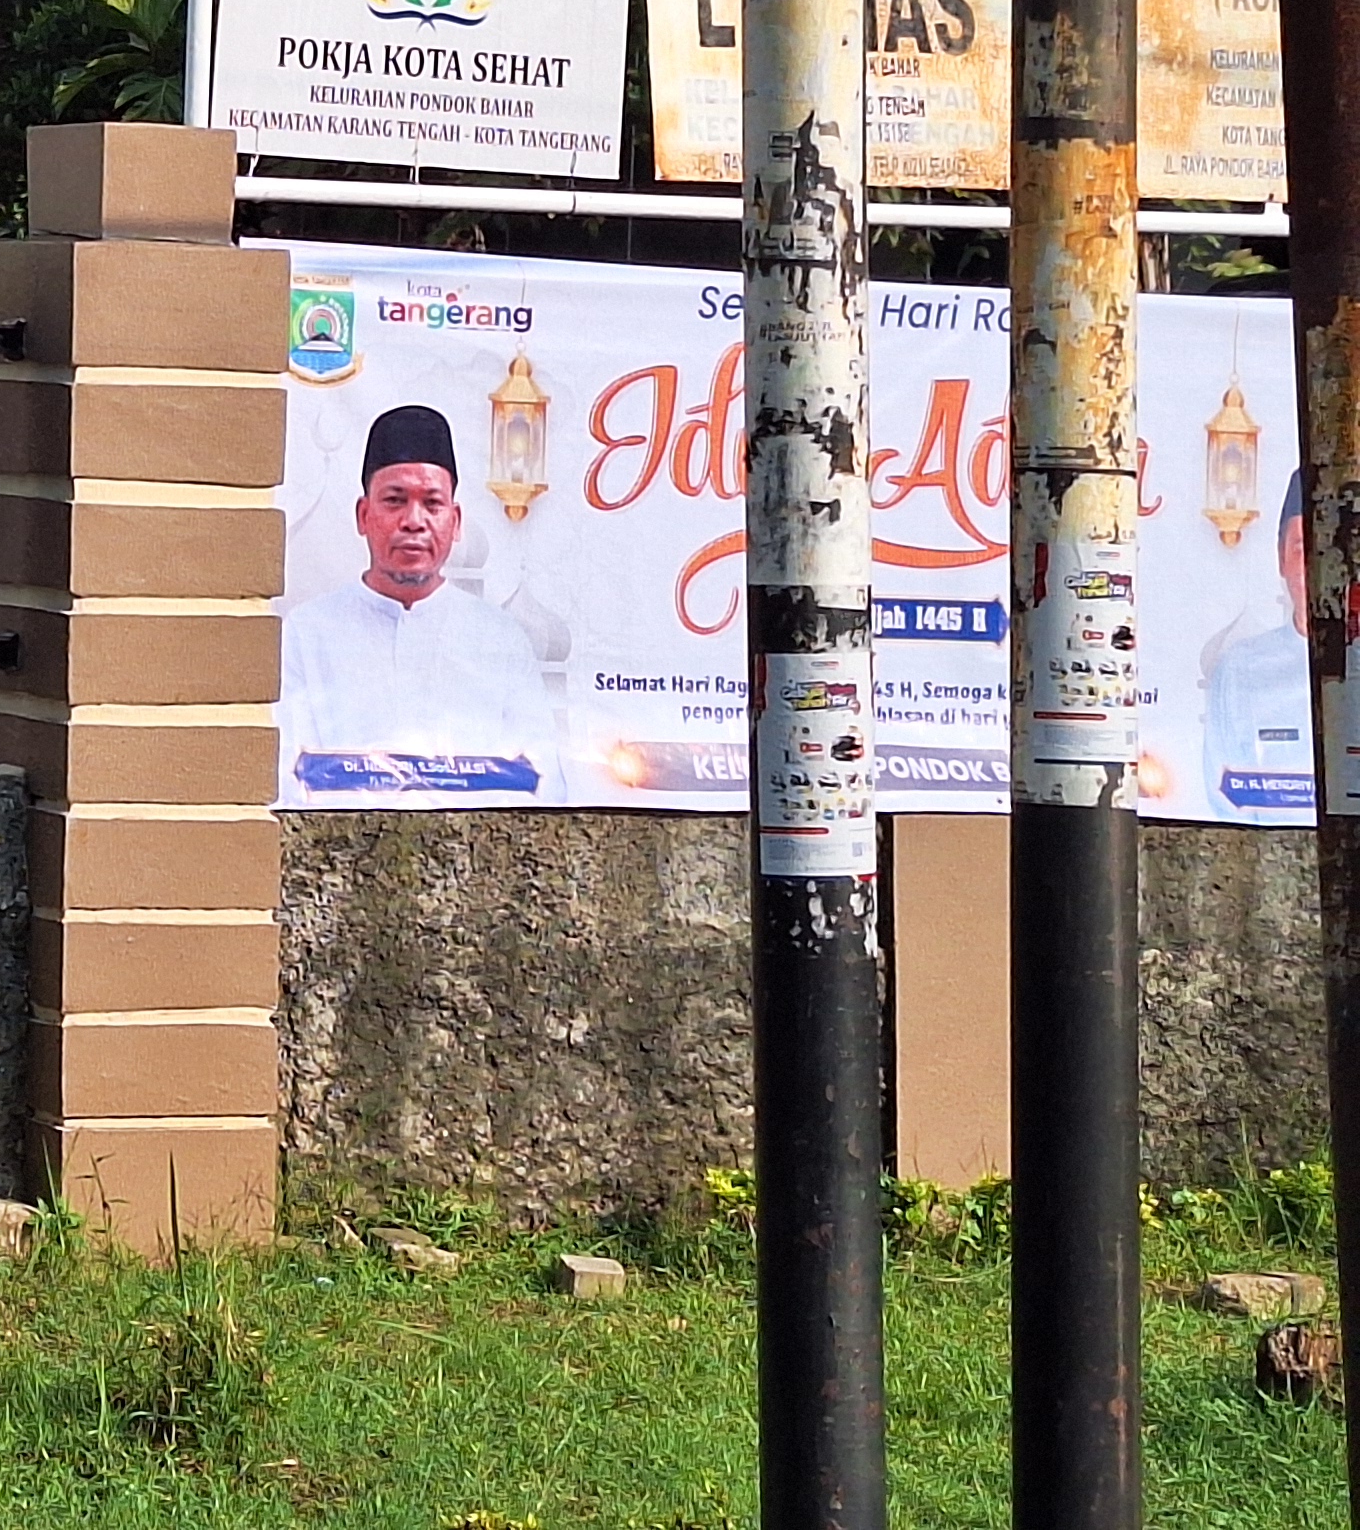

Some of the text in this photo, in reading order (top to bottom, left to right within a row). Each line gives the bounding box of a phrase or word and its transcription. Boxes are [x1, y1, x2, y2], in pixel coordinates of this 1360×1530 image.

[277, 36, 572, 88] POKJA KOTA SEHAT
[310, 85, 534, 119] KELURAHAN PONDOK BAHAR
[229, 108, 323, 134] KECAMATAN
[327, 115, 392, 138] KARANG
[398, 120, 461, 143] TENGAH
[474, 126, 515, 146] KOTA
[519, 129, 612, 154] TANGERANG
[407, 280, 442, 298] kota
[378, 296, 533, 333] tangerang
[879, 294, 960, 331] Hari
[595, 672, 666, 692] Selamat
[672, 675, 710, 693] Hari
[922, 681, 992, 704] Semoga
[961, 708, 998, 727] hari
